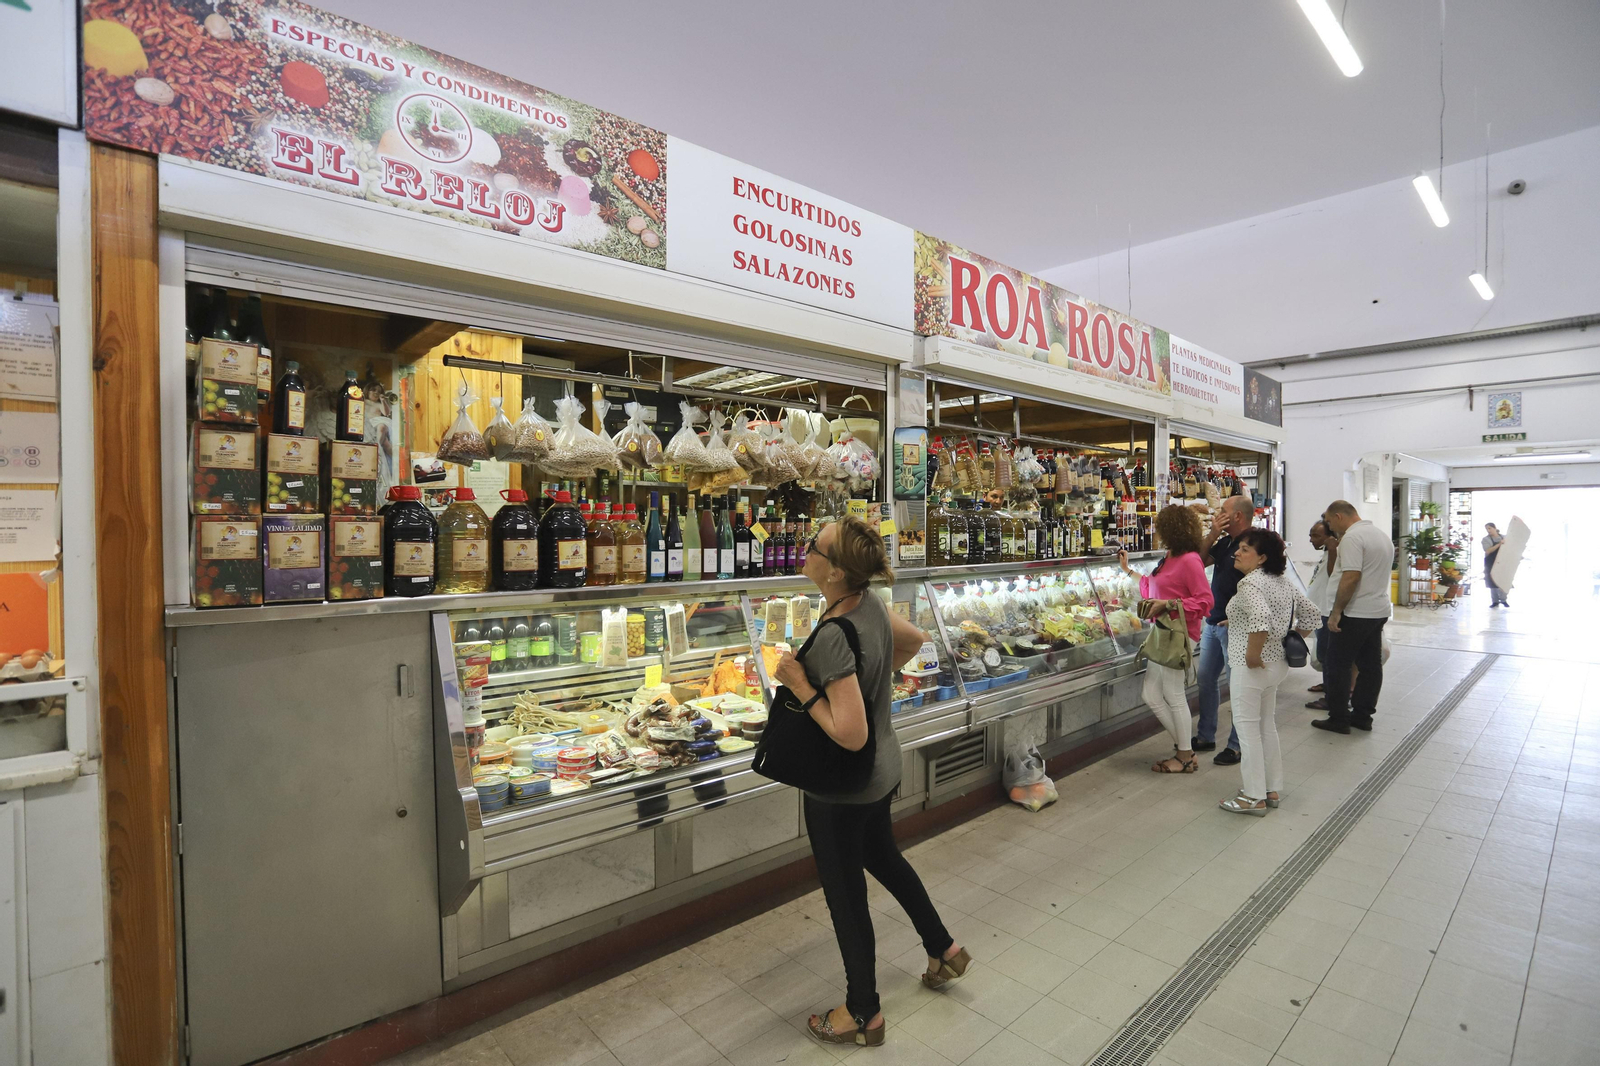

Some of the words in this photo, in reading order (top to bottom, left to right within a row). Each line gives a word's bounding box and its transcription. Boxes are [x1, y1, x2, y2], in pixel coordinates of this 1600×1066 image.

[272, 18, 395, 72] ESPECIAS
[401, 62, 415, 78] Y
[422, 70, 568, 129] CONDIMENTOS
[271, 127, 359, 186] EL
[381, 157, 566, 233] RELOJ
[732, 176, 861, 238] ENCURTIDOS
[732, 213, 853, 267] GOLOSINAS
[732, 249, 855, 300] SALAZONES
[948, 255, 1050, 352] ROA
[1067, 300, 1157, 384] ROSA
[1171, 344, 1198, 363] PLANTAS
[1199, 355, 1231, 376] MEDICINALES
[1172, 362, 1180, 373] TE
[1214, 378, 1240, 396] INFUSIONES
[1172, 381, 1219, 404] HERBODIETETICA
[1485, 433, 1523, 443] SALIDA
